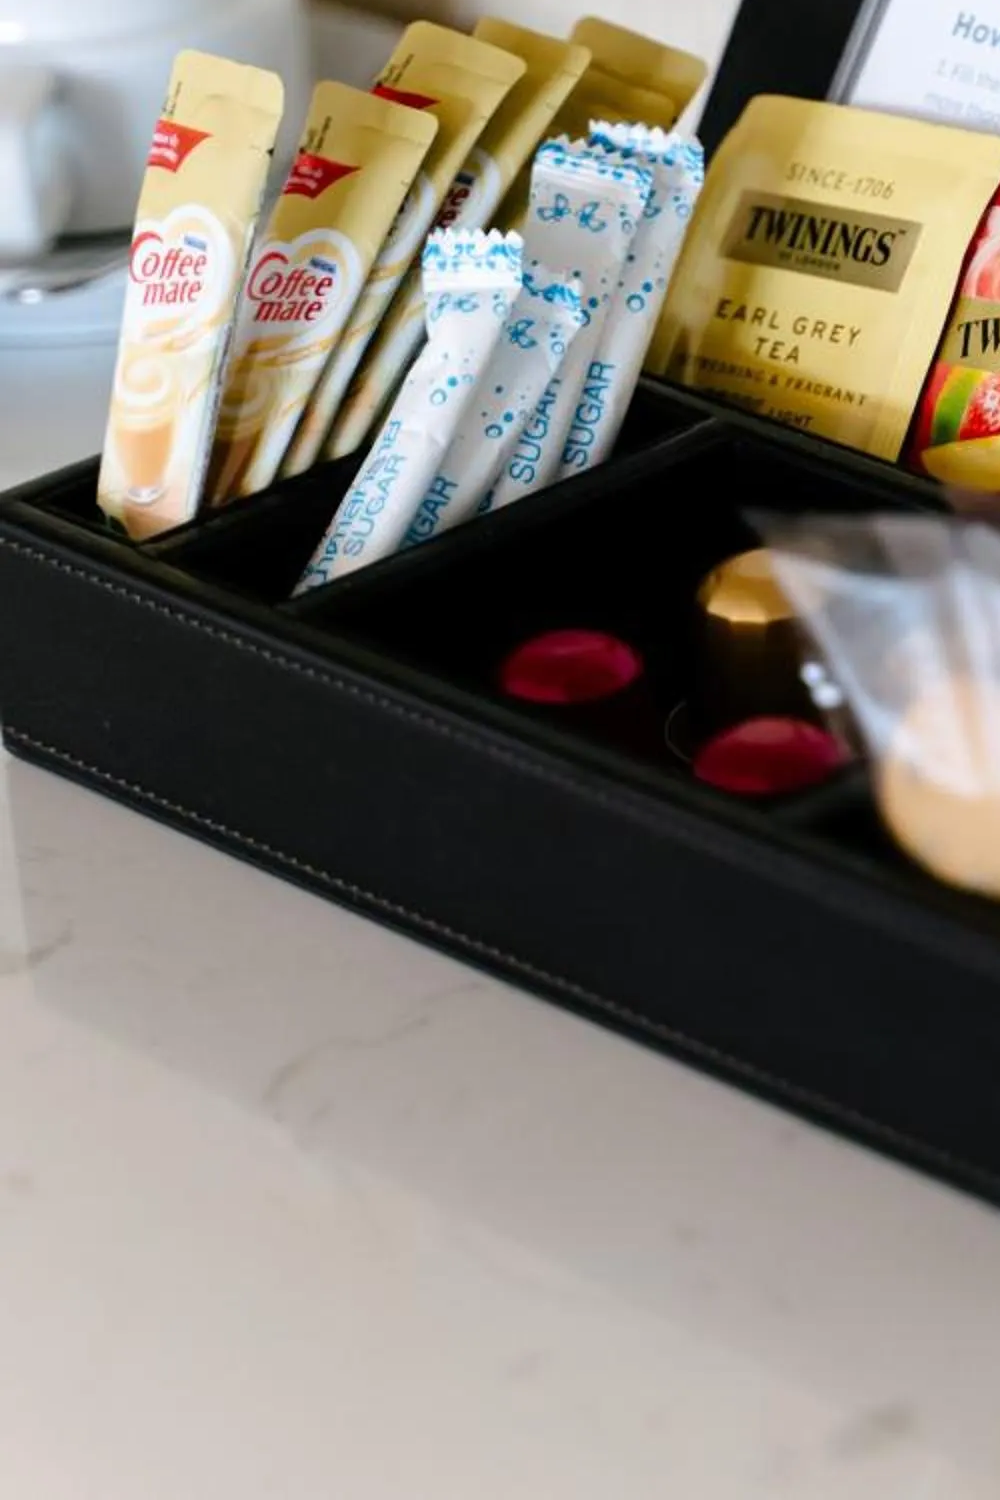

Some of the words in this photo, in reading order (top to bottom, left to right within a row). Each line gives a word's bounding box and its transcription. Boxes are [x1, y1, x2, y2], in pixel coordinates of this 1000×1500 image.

[129, 231, 208, 284] Coffee
[745, 205, 898, 267] TWININGS
[142, 278, 203, 307] mate
[249, 251, 334, 300] Coffee
[254, 299, 323, 322] mate
[715, 297, 780, 330] EARL
[792, 315, 863, 348] GREY
[753, 336, 801, 364] TEA
[563, 360, 617, 469] SUGAR
[785, 376, 869, 406] FRAGRANT
[343, 452, 407, 558] SUGAR
